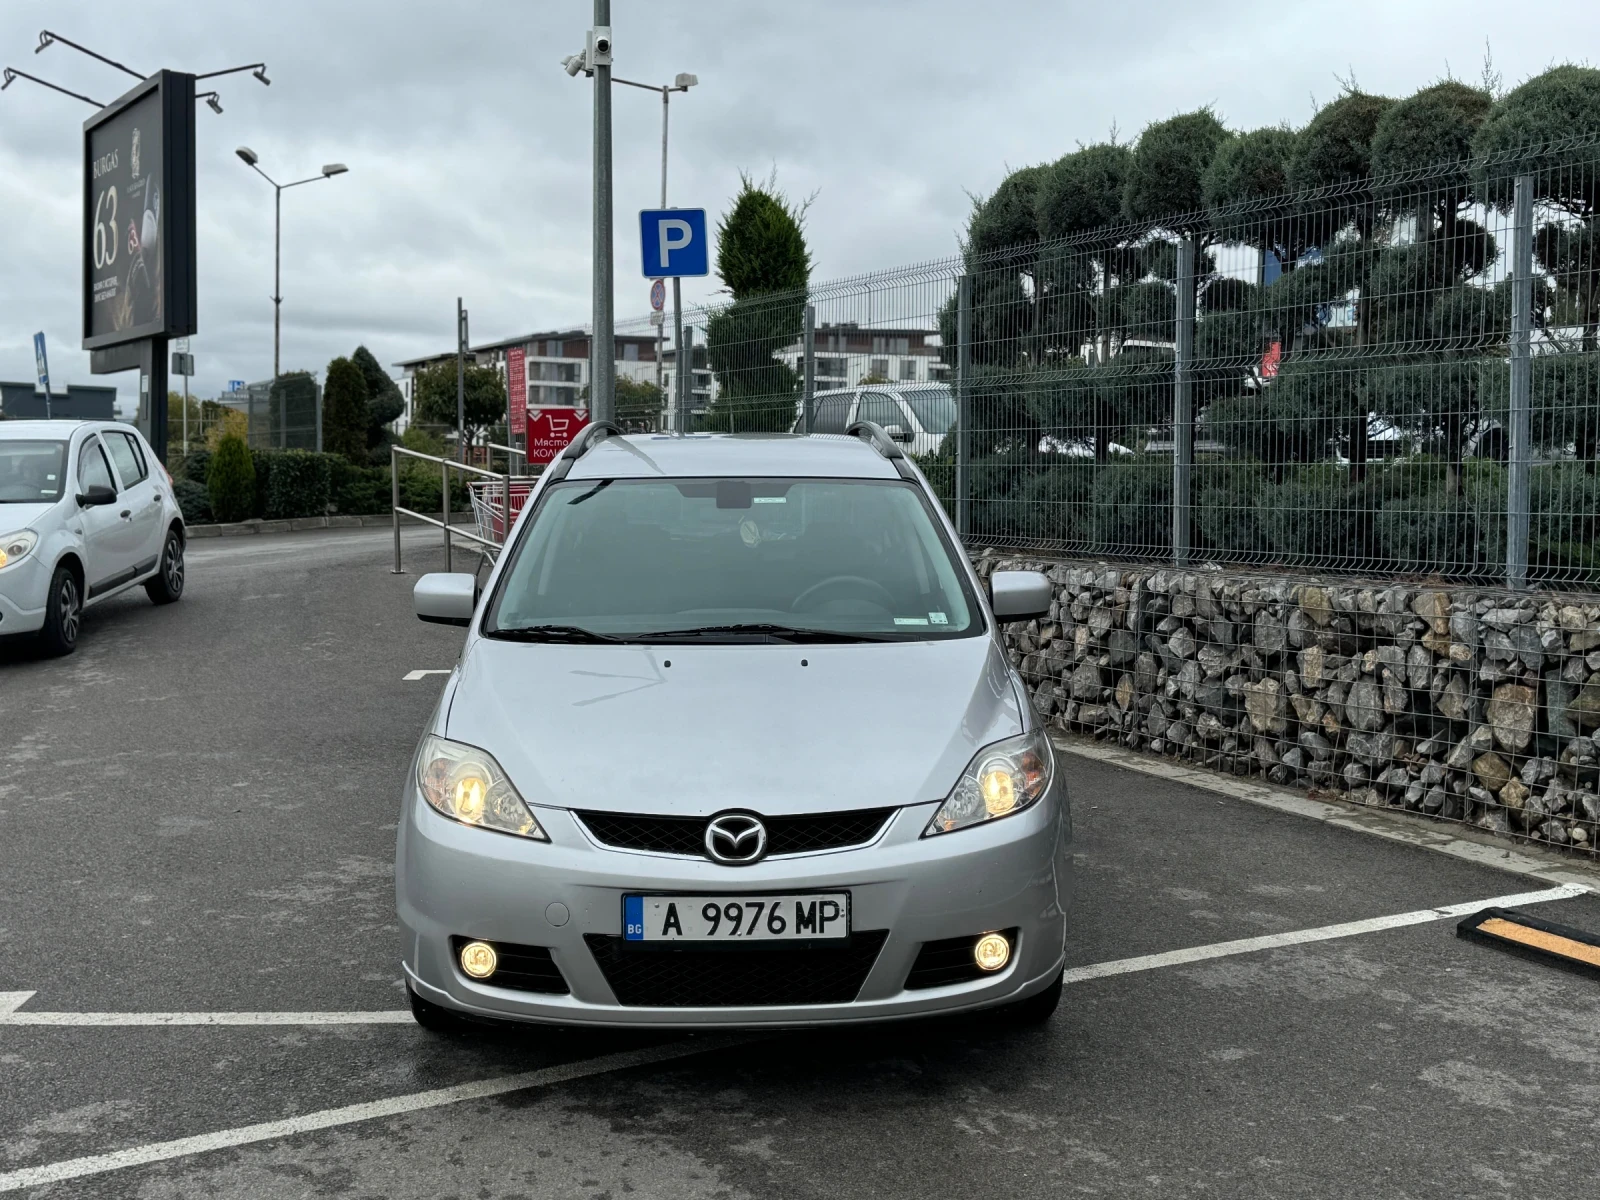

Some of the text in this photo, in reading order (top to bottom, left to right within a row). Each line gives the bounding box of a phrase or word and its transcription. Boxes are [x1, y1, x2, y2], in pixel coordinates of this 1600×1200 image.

[93, 148, 119, 179] BURGAS
[93, 185, 118, 269] 63
[658, 219, 693, 268] P
[534, 437, 569, 447] Място
[627, 924, 642, 934] BG
[661, 900, 840, 936] A 9976 MP
